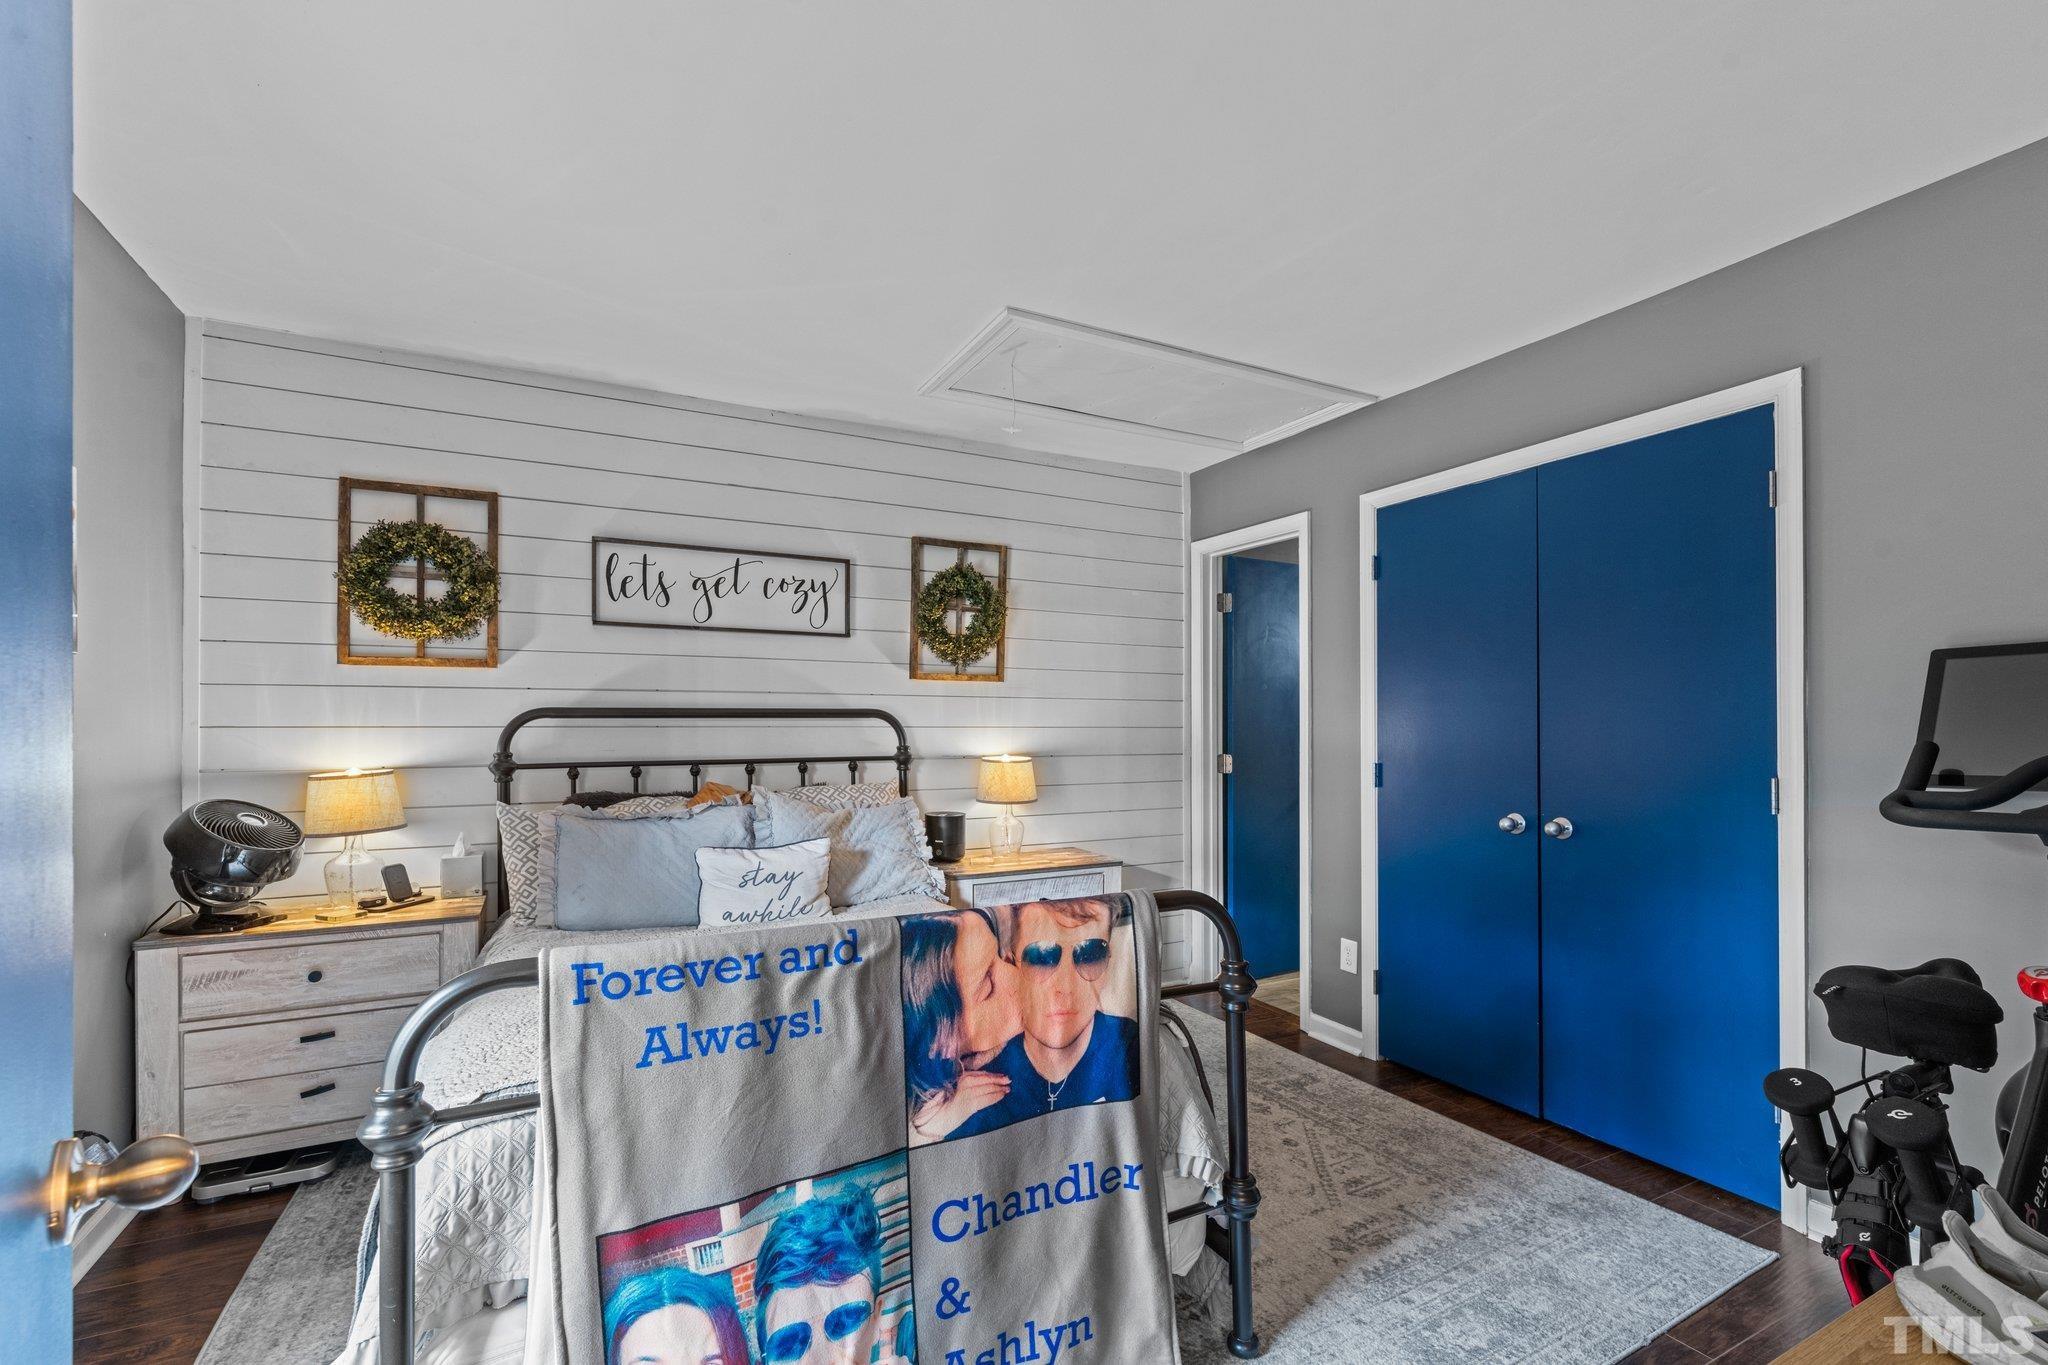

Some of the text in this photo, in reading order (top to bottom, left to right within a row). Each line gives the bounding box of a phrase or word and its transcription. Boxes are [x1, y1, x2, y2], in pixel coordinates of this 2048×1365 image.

[605, 552, 839, 630] lets get cozy
[722, 895, 814, 924] awhile
[738, 860, 804, 901] stay
[570, 928, 863, 1006] Forever and
[635, 999, 824, 1069] Always!
[931, 1160, 1144, 1243] Chandler
[934, 1276, 972, 1320] &
